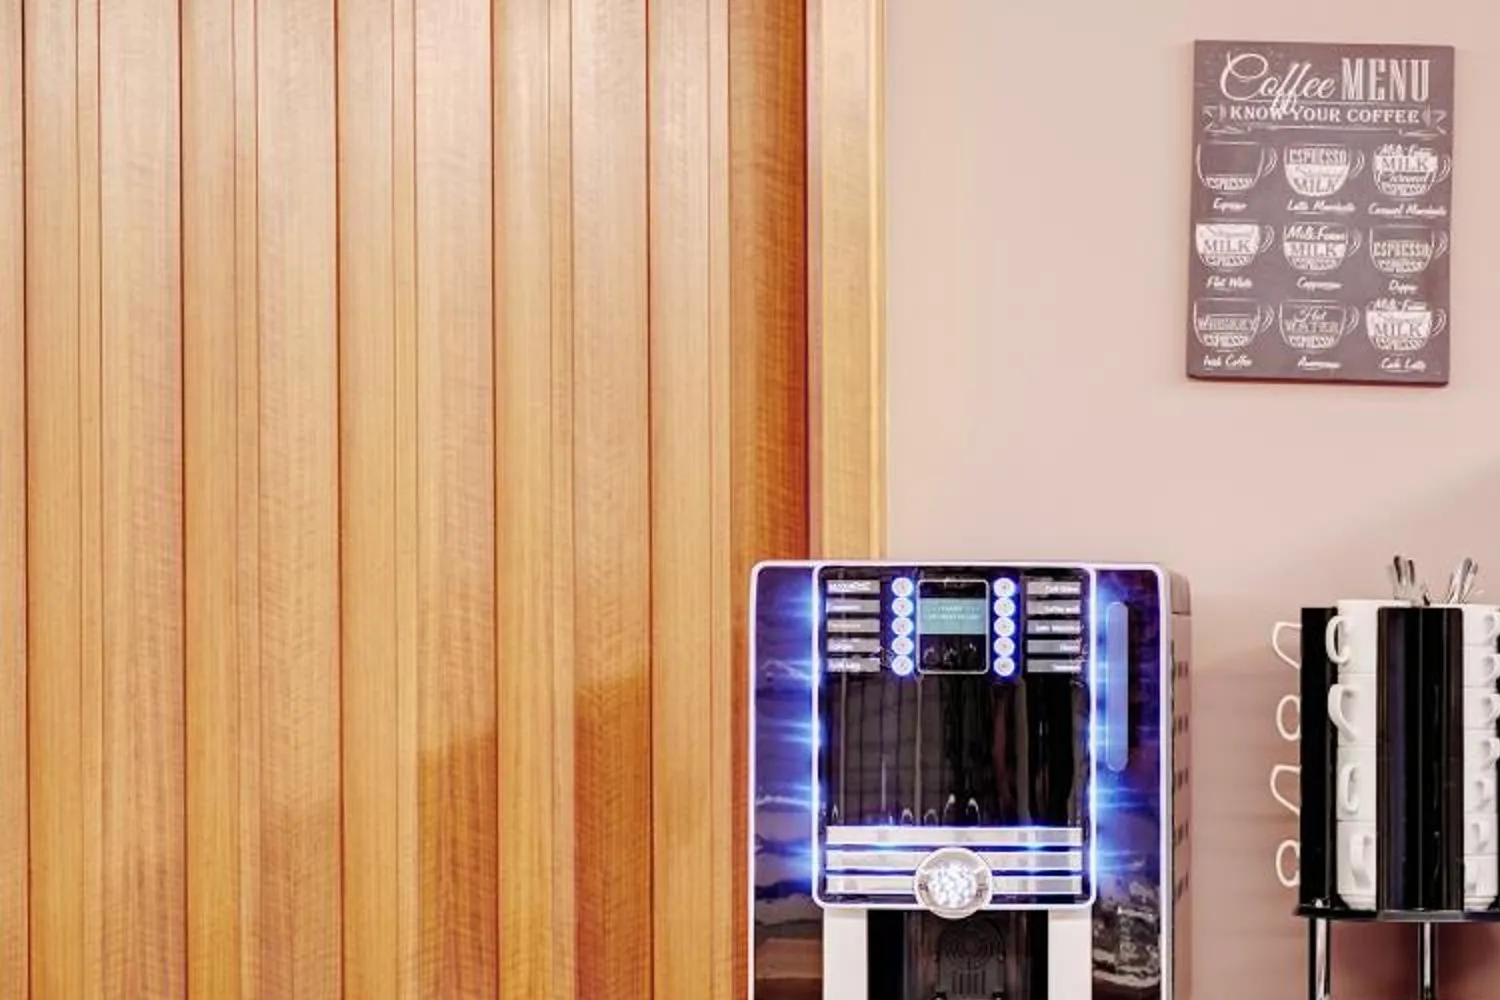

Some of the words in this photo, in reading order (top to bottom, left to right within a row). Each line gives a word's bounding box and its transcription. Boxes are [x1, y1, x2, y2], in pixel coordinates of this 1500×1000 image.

[1220, 52, 1337, 116] Coffee
[1341, 57, 1431, 101] MENU
[1230, 104, 1285, 122] KNOW
[1292, 106, 1341, 123] YOUR
[1346, 108, 1421, 125] COFFEE
[1204, 239, 1252, 254] MILK
